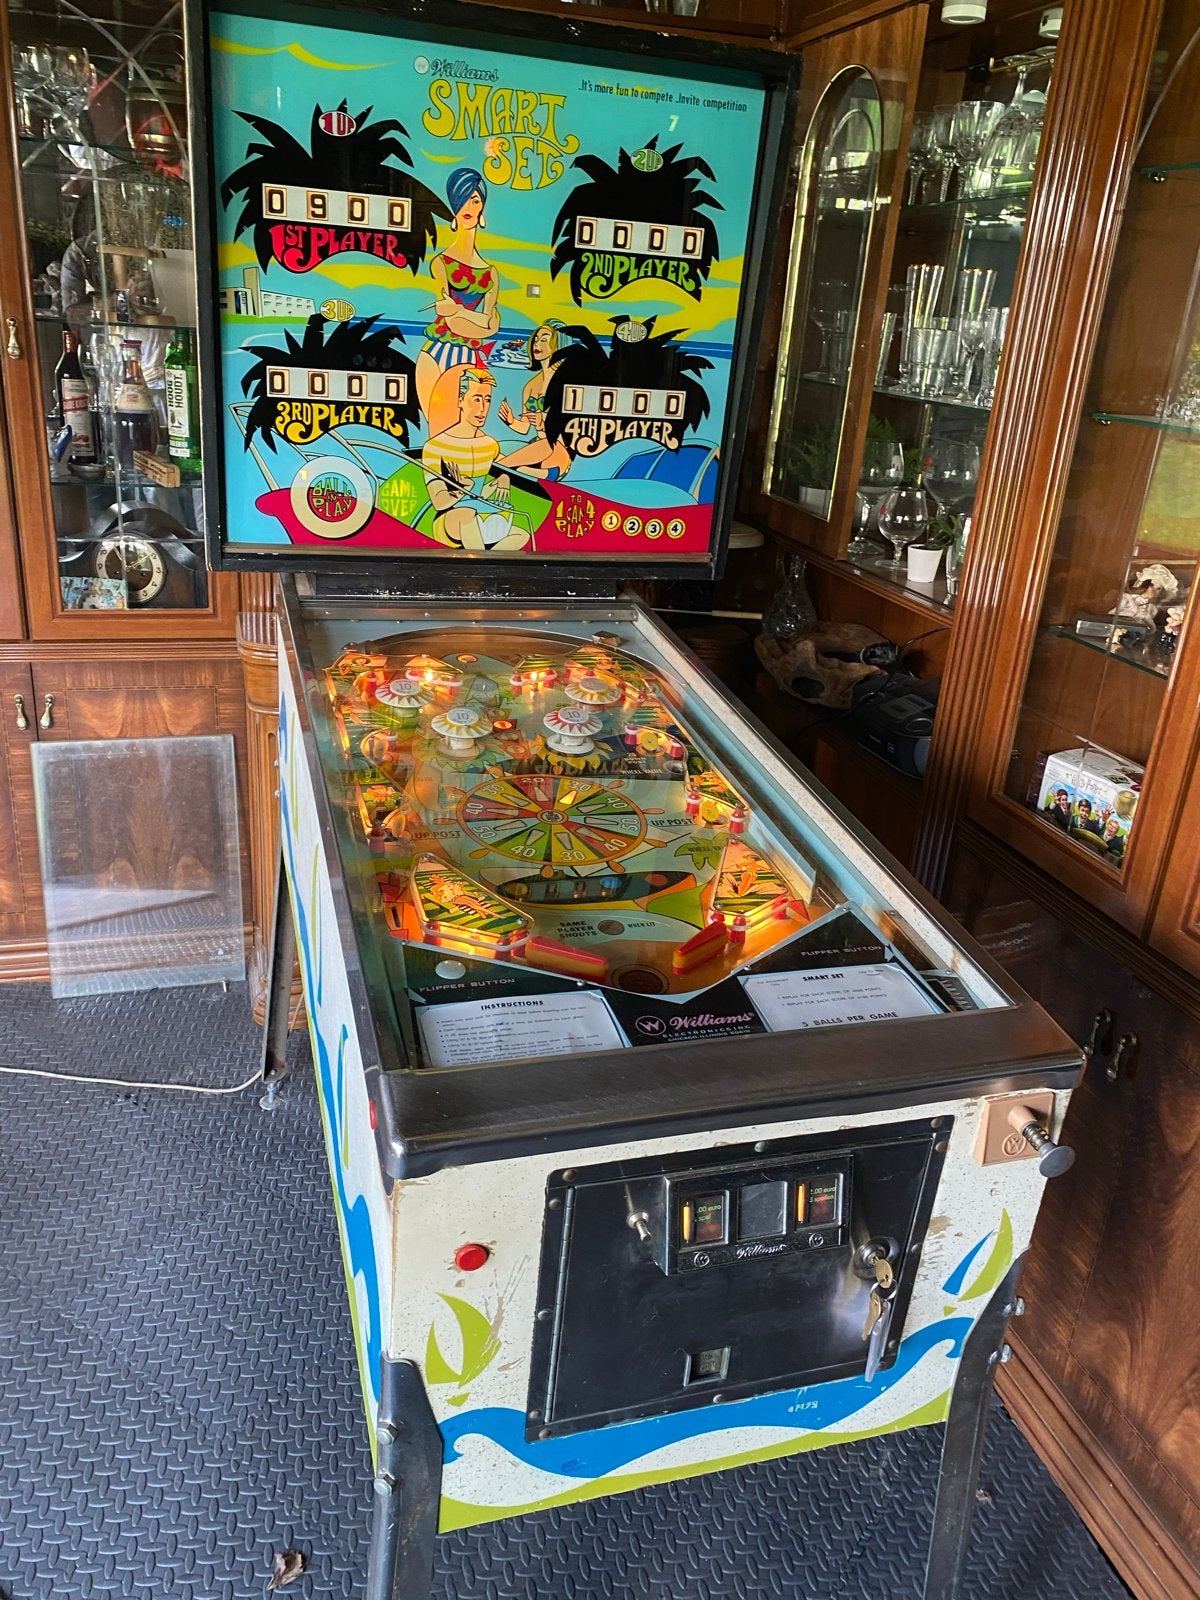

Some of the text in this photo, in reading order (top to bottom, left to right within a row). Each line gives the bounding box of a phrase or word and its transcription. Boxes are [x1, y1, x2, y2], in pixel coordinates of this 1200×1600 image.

[431, 58, 499, 82] Williams
[594, 83, 613, 94] more
[615, 83, 629, 96] fun
[631, 87, 639, 98] to
[641, 89, 673, 103] compete
[703, 97, 747, 112] competition
[422, 79, 580, 154] SMART
[483, 136, 565, 191] SET
[313, 477, 352, 496] BALL
[381, 480, 418, 498] GAME
[313, 498, 352, 517] PLAY
[381, 499, 418, 517] OVER
[571, 494, 582, 503] TO
[586, 500, 596, 518] 4
[566, 505, 584, 523] CAN
[555, 520, 594, 538] PLAY
[398, 682, 413, 691] 10
[456, 712, 470, 720] 10
[567, 710, 581, 719] 10
[569, 780, 591, 792] 30
[466, 802, 484, 815] 40
[607, 797, 628, 809] 40
[621, 818, 640, 832] 50
[666, 818, 693, 826] POST
[414, 830, 461, 839] UP POST
[473, 826, 497, 839] 50
[511, 845, 537, 857] 40
[604, 838, 627, 852] 40
[561, 851, 585, 861] 30
[560, 920, 587, 928] SAME
[558, 931, 598, 939] SHOOTS
[801, 945, 882, 957] FLIPPER BUTTON
[802, 974, 830, 982] SMART
[419, 977, 515, 993] FLIPPER BUTTON
[481, 999, 544, 1011] INSTRUCTIONS
[815, 1016, 843, 1027] BALLS
[848, 1014, 866, 1023] PER
[869, 1011, 899, 1021] GAME
